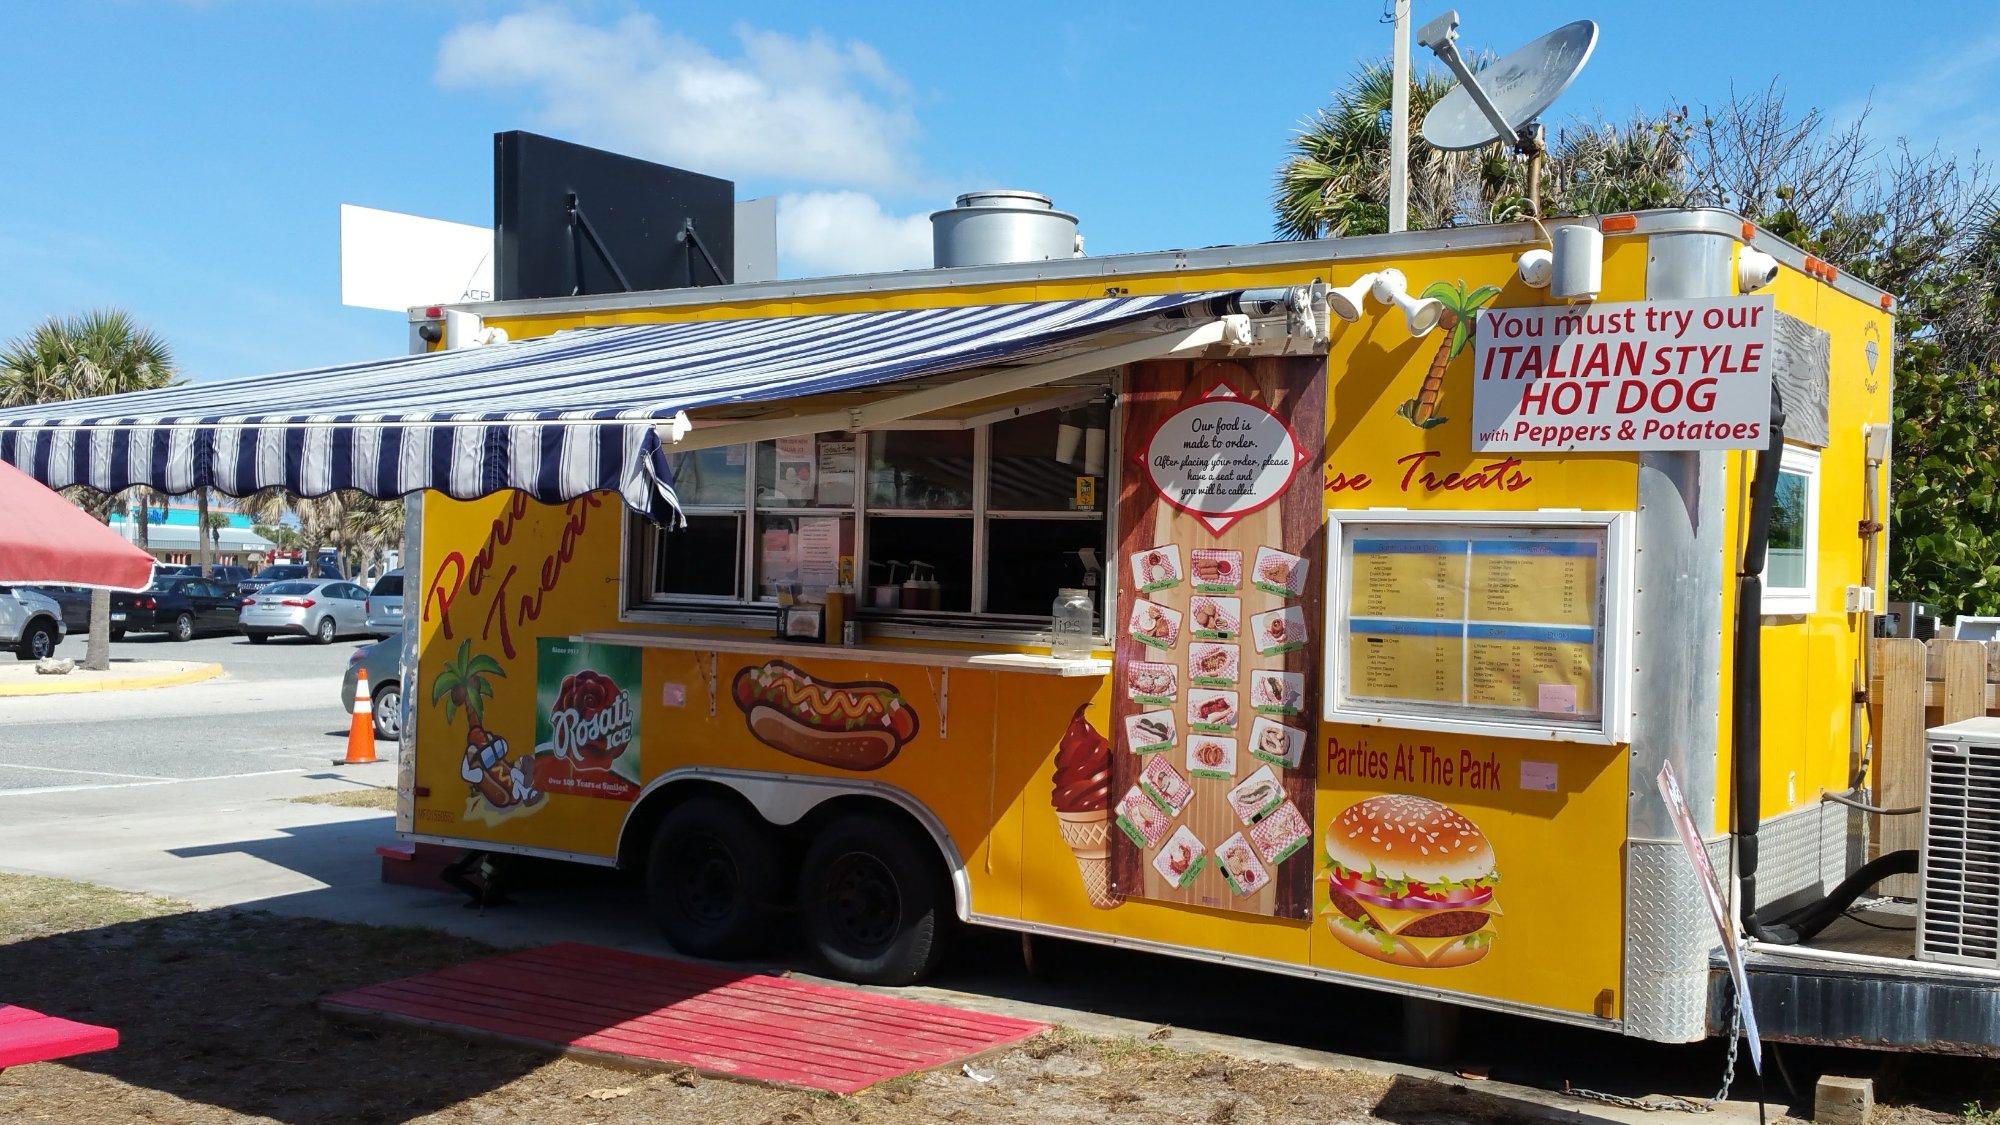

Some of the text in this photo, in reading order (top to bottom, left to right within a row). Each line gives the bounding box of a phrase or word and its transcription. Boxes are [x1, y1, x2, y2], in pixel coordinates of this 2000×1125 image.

[1487, 305, 1764, 339] You must try our
[1482, 341, 1764, 380] ITALIAN STYLE
[1519, 377, 1718, 416] HOT DOG
[1191, 416, 1252, 434] Our food is
[1479, 419, 1761, 447] with Peppers & Potatoes
[1183, 434, 1258, 449] made to order.
[1154, 454, 1289, 472] After placing your order, please
[1187, 469, 1253, 481] have a seat and
[1397, 450, 1533, 492] Treats
[1181, 482, 1256, 500] you will be called.
[550, 690, 633, 761] Rosati
[607, 728, 632, 750] ICE
[1327, 737, 1501, 792] Parties At The Park
[548, 777, 561, 786] Over
[563, 778, 575, 786] 100
[576, 779, 595, 789] Years
